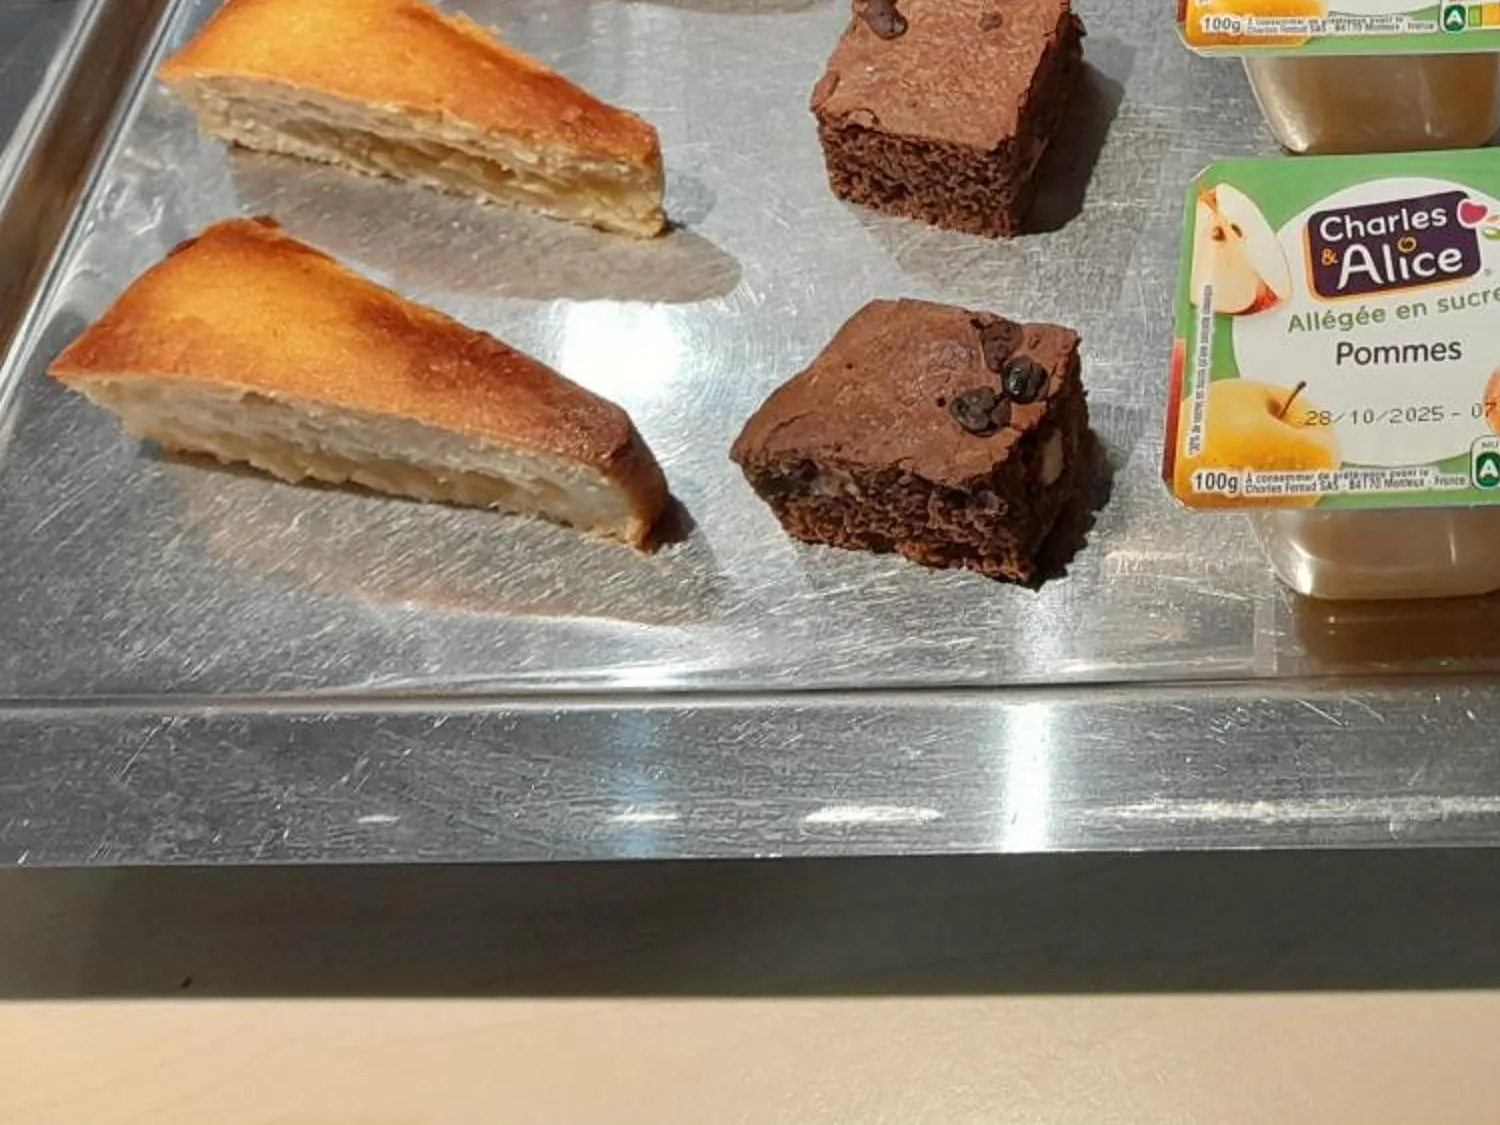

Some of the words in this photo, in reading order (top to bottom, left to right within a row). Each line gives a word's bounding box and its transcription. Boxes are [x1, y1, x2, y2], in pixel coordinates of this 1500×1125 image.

[1204, 17, 1241, 34] 100g
[1319, 207, 1448, 242] Charles
[1321, 248, 1339, 266] &
[1336, 243, 1463, 290] Alice
[1287, 305, 1387, 333] Allégée
[1396, 302, 1428, 320] en
[1336, 340, 1462, 366] Pommes
[1304, 405, 1446, 426] 28/10/2025
[1195, 472, 1239, 493] 100g
